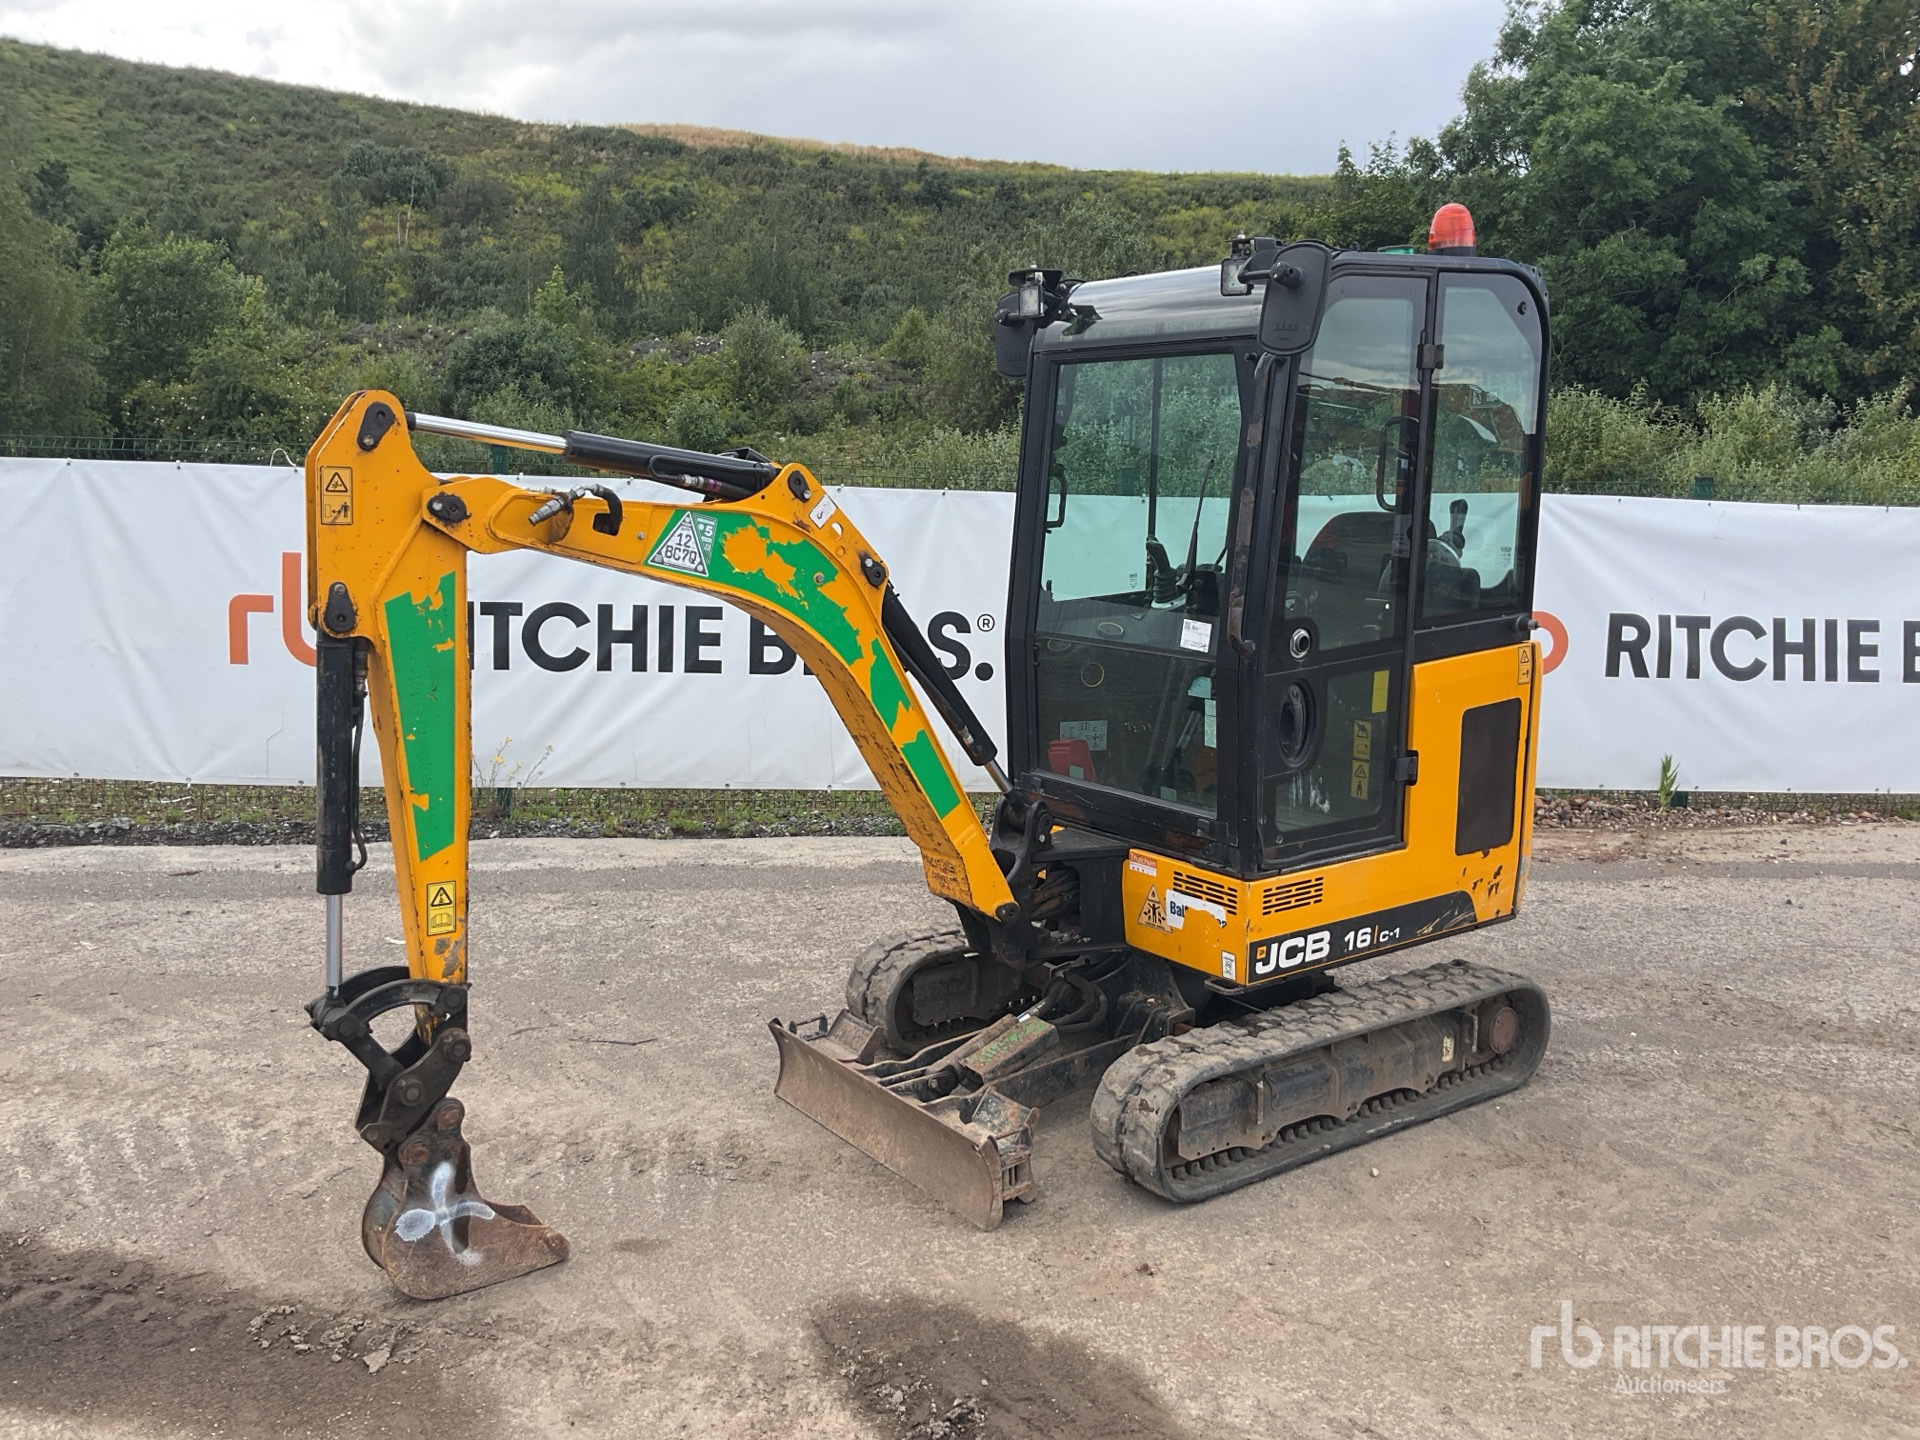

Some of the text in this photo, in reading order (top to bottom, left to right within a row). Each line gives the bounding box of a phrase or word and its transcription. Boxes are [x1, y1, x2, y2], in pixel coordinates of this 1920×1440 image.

[675, 532, 692, 549] 12
[704, 525, 714, 537] 5
[664, 544, 698, 565] BC7Q
[467, 600, 724, 674] TCHIE
[1604, 612, 1881, 684] RITCHIE
[1254, 930, 1331, 975] JCB
[1344, 927, 1372, 951] 16
